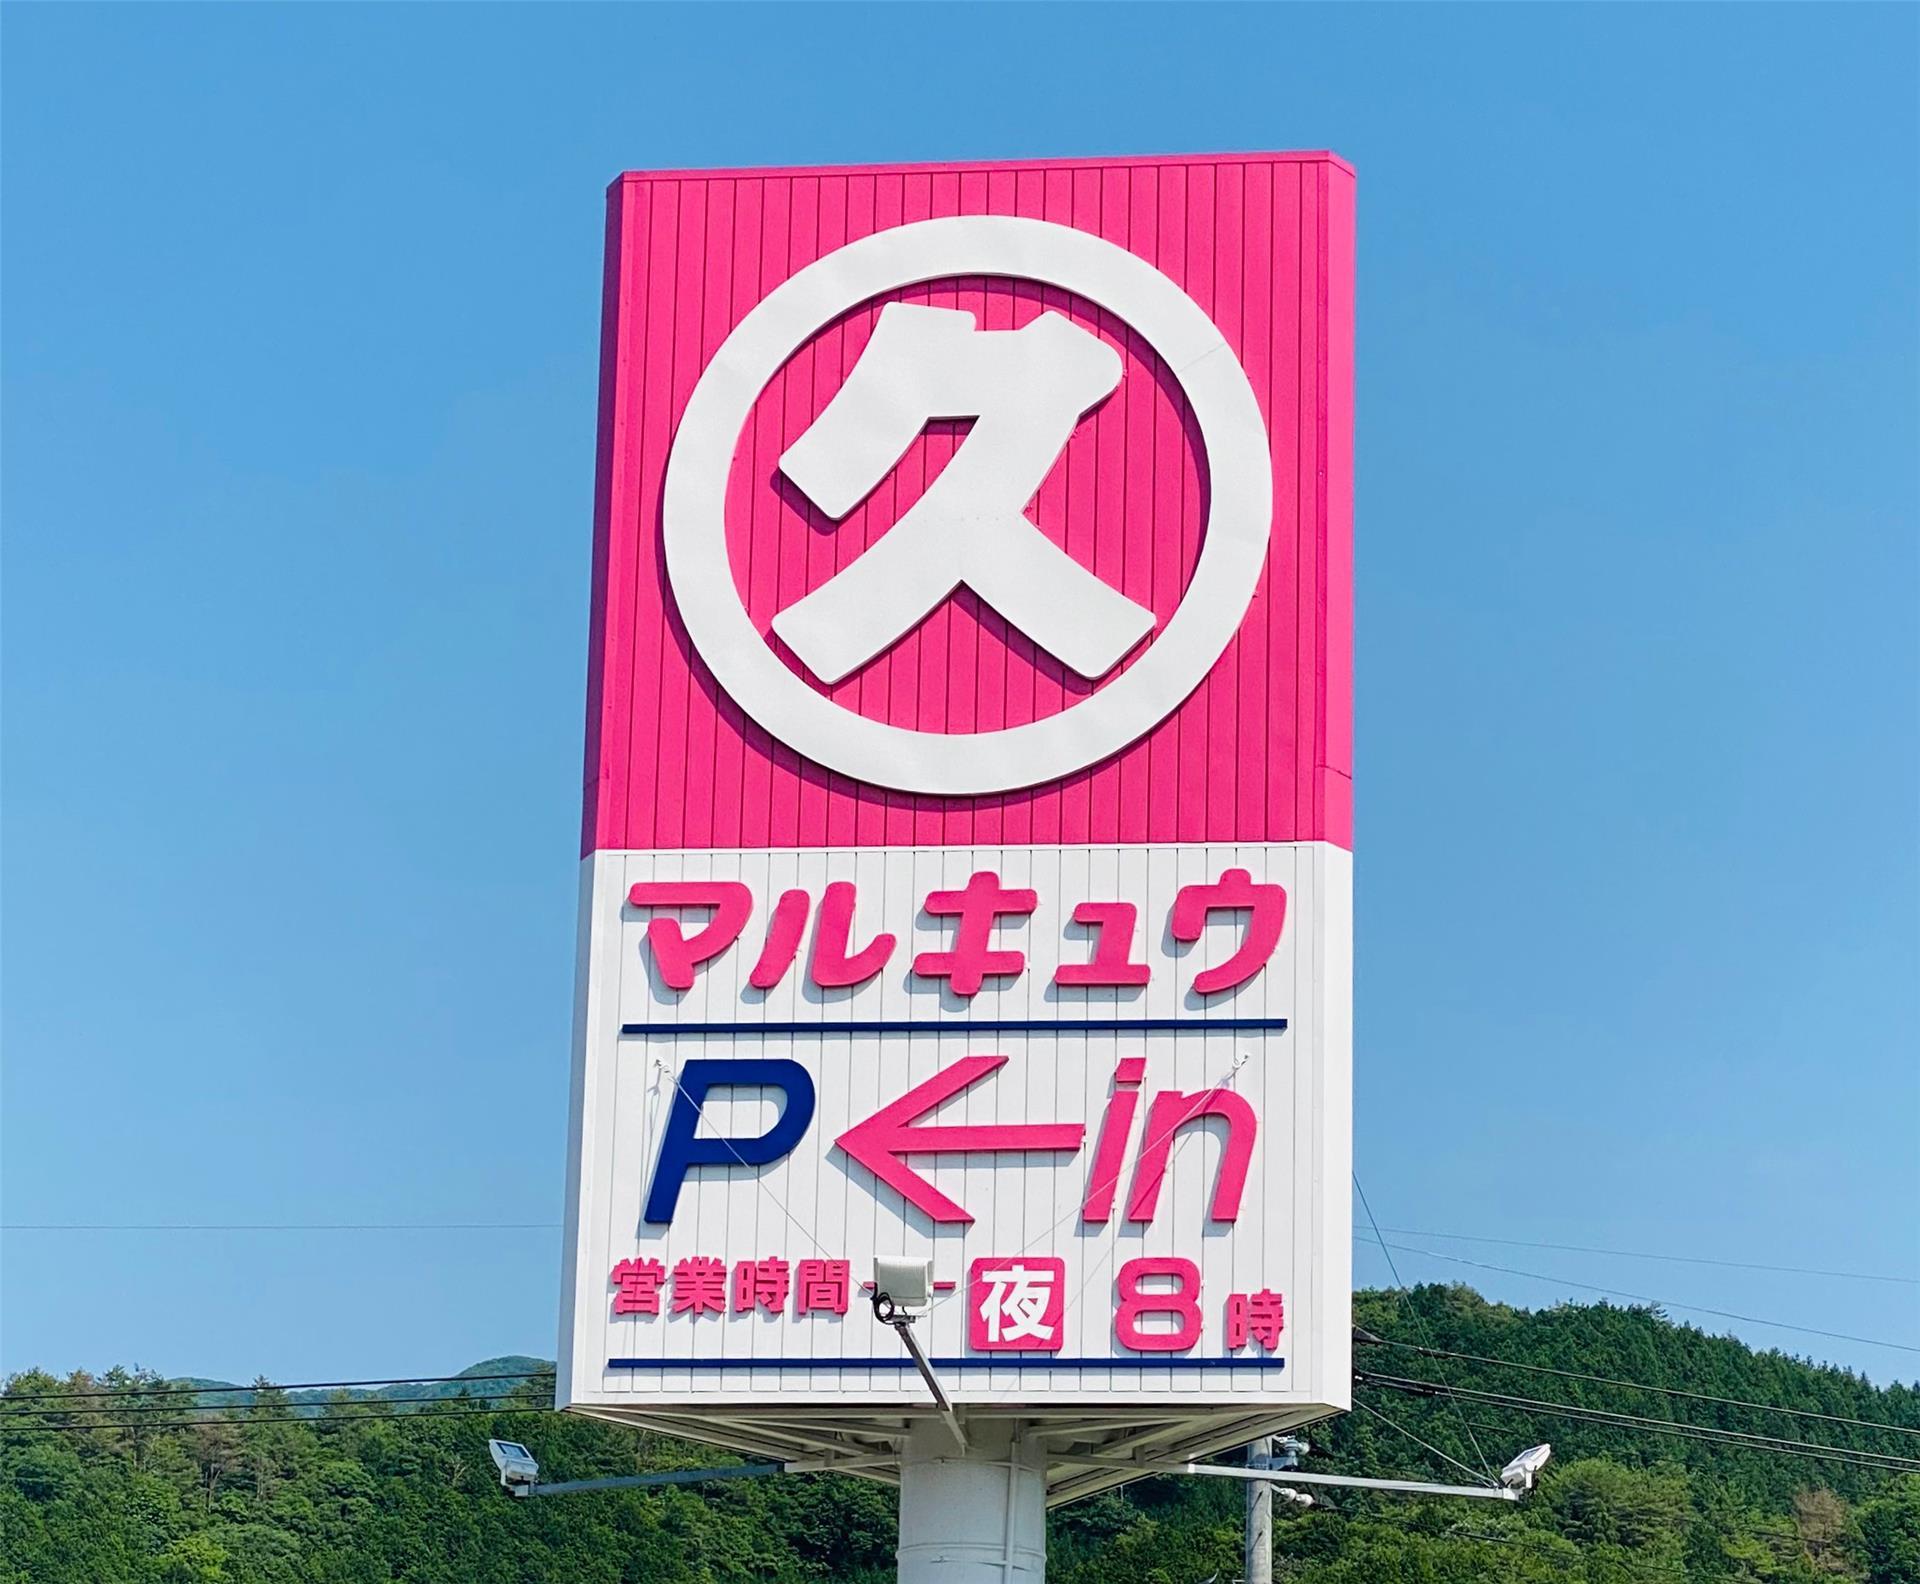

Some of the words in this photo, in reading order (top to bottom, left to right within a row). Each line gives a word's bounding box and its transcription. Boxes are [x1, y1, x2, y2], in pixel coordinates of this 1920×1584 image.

[628, 868, 1287, 996] マルキュウ
[644, 1058, 816, 1224] P
[1082, 1057, 1258, 1222] in
[611, 1257, 850, 1316] 営業時間
